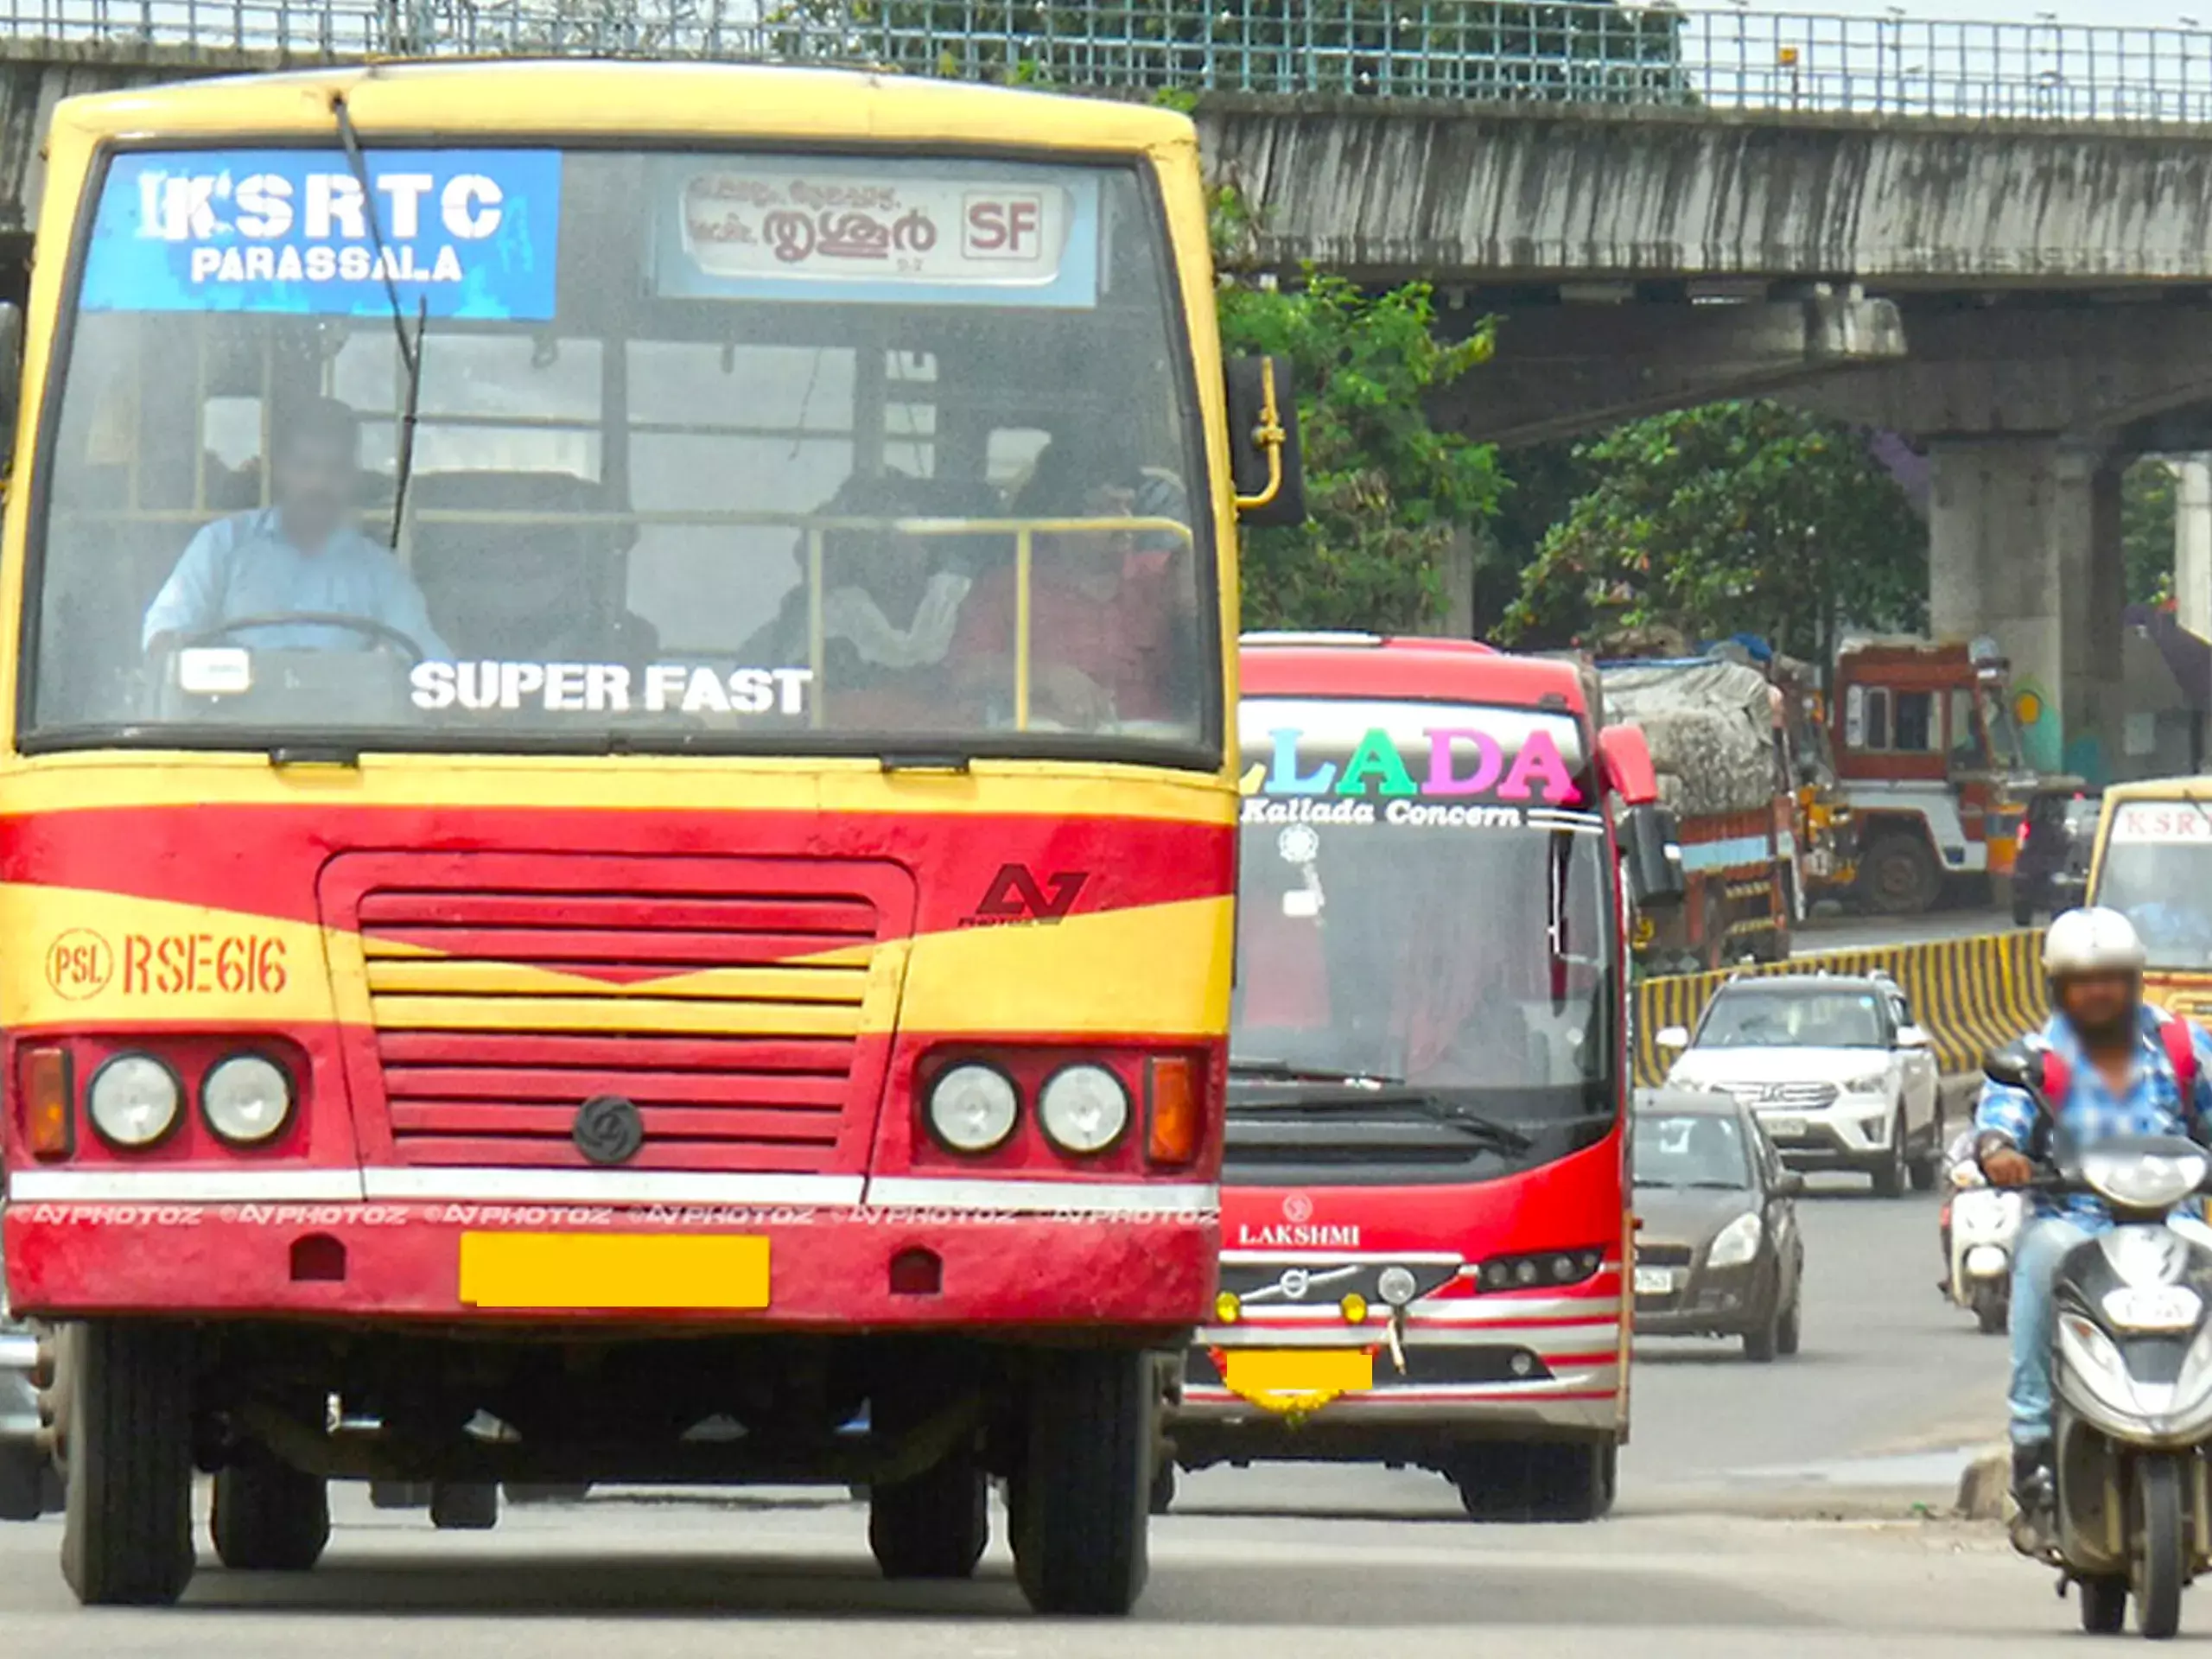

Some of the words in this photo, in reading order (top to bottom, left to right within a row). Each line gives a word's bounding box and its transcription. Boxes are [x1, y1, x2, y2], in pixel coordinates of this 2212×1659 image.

[160, 173, 504, 239] KSRTC
[967, 201, 1037, 251] SF
[190, 245, 462, 283] PARASSALA
[410, 659, 630, 710] SUPER
[644, 666, 813, 714] FAST
[1240, 797, 1376, 824] Kallada
[1385, 798, 1521, 828] Concern
[2126, 810, 2212, 836] KSR
[55, 944, 102, 985] PSL
[1239, 1224, 1360, 1246] LAKSHMI
